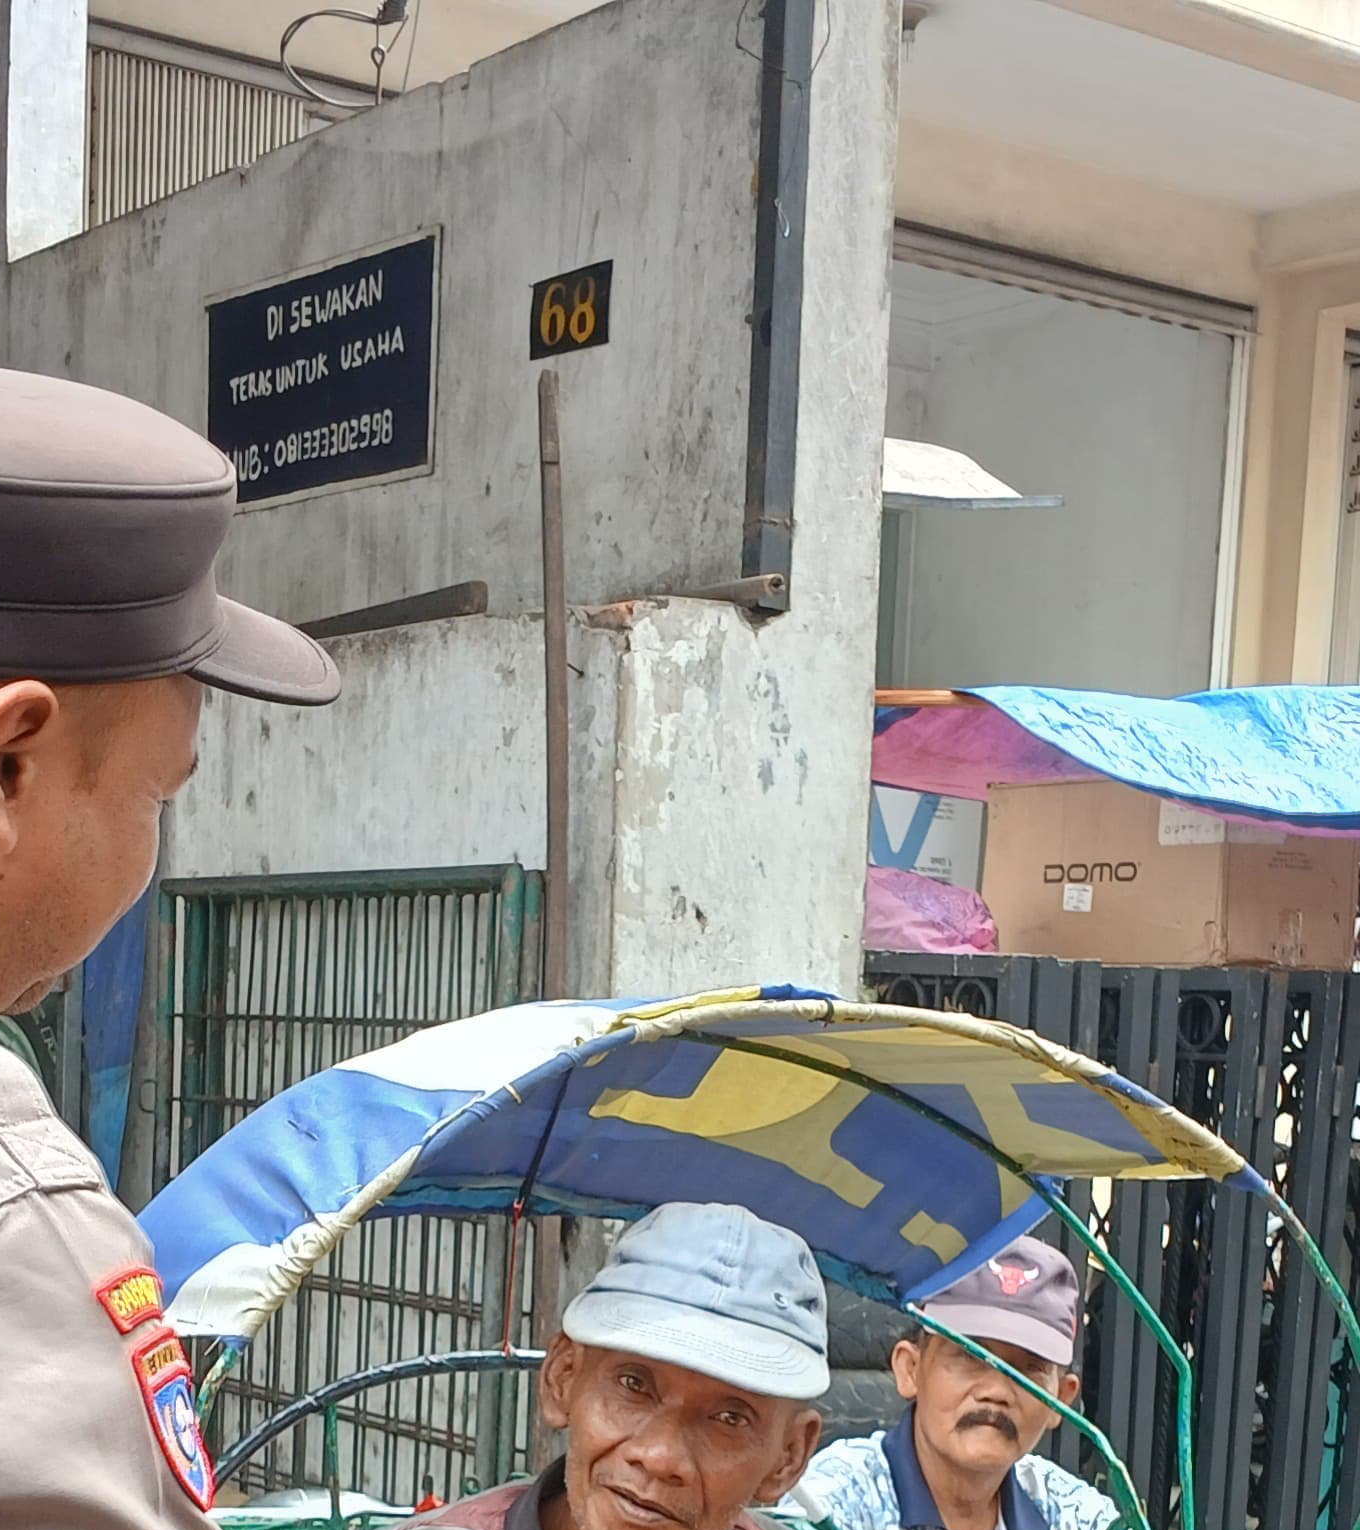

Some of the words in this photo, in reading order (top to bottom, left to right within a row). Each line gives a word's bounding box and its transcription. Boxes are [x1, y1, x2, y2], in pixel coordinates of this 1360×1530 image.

[266, 304, 284, 341] DI
[289, 269, 384, 335] SEWAKAN
[540, 276, 596, 347] 68
[229, 368, 273, 405] TERAS
[275, 352, 329, 394] UNTUK
[340, 325, 405, 371] USAHA
[274, 408, 393, 468] 081333302998
[1044, 862, 1137, 884] DOMO
